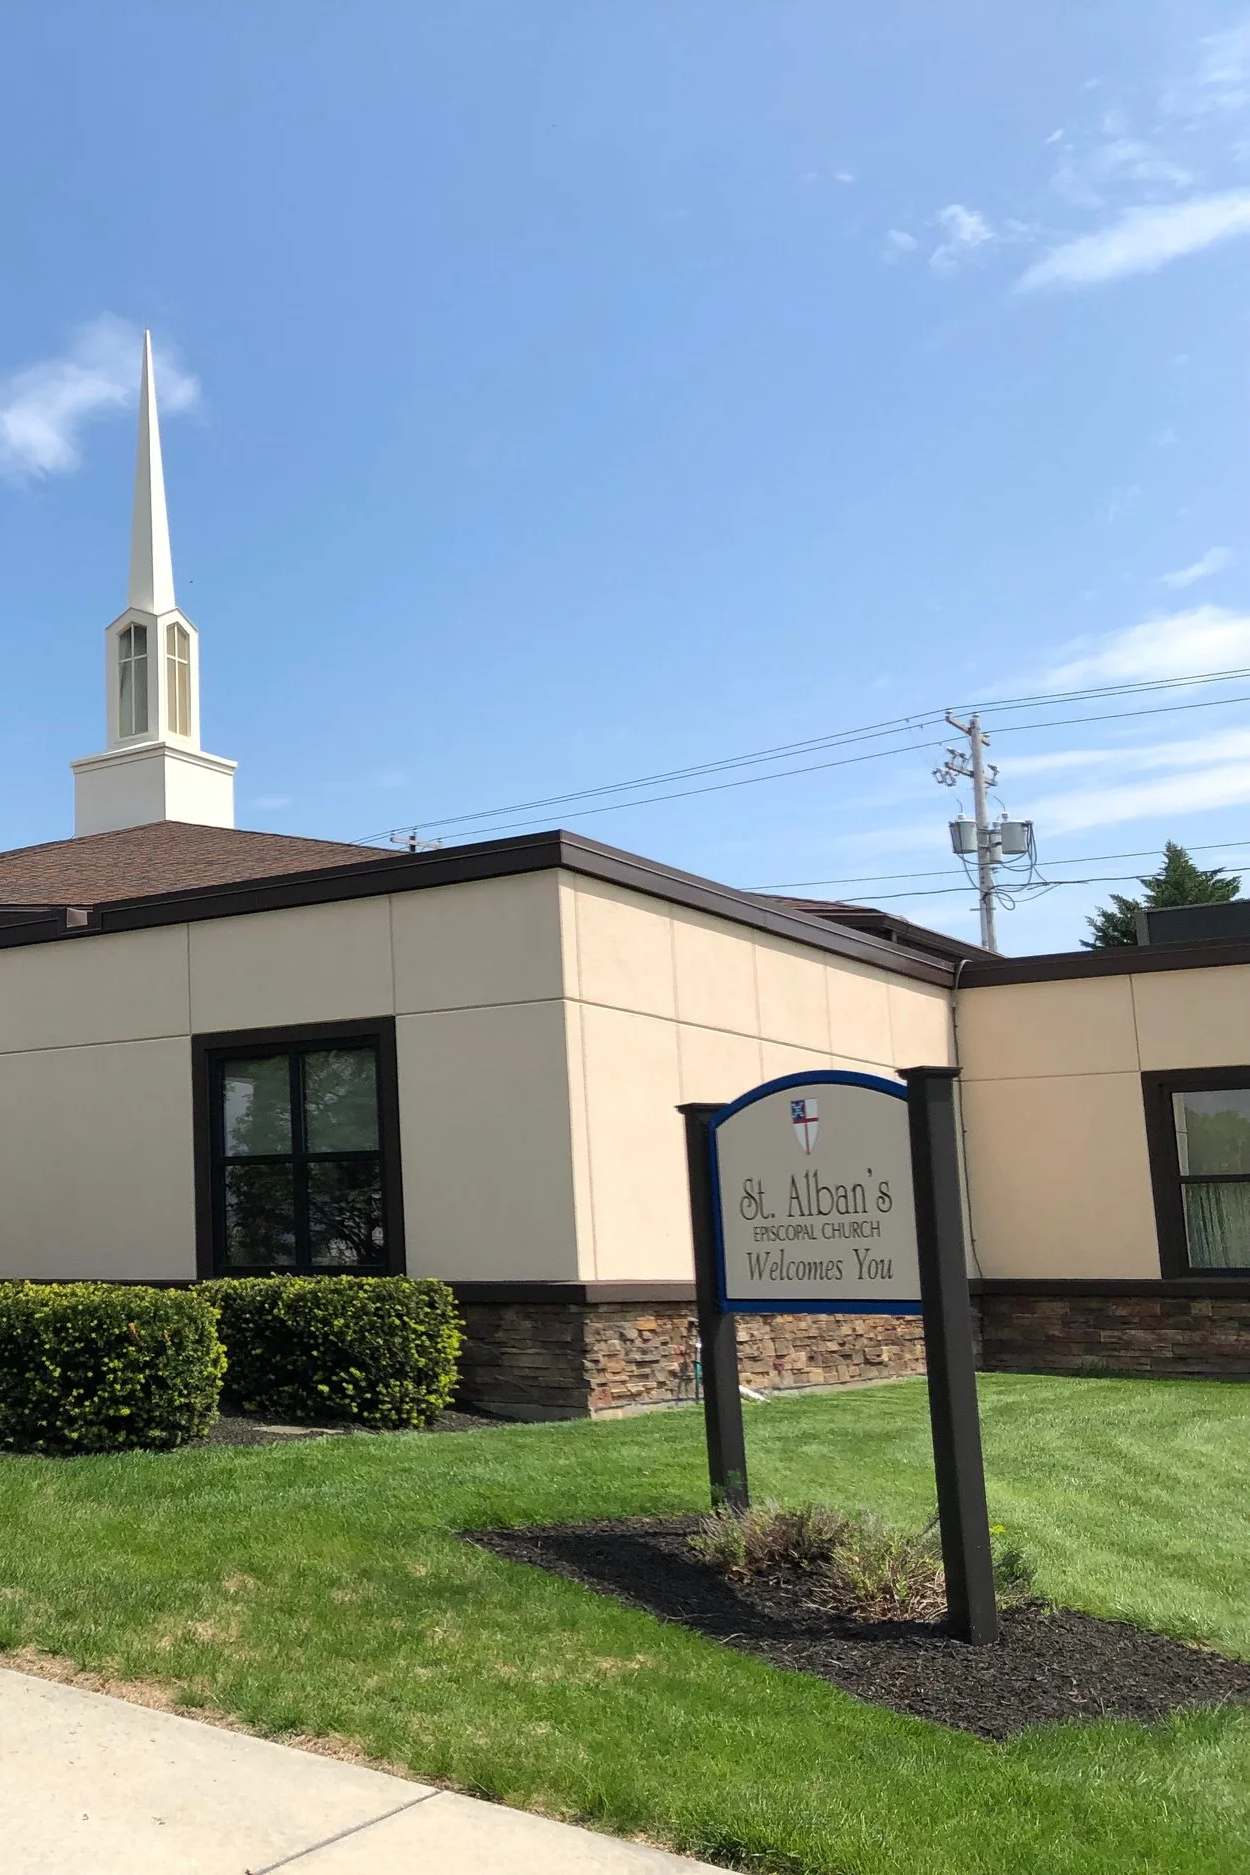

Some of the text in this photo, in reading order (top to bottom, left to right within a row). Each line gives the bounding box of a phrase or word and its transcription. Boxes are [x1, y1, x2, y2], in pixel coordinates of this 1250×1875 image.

[739, 1168, 893, 1221] St. Alban's
[753, 1220, 881, 1242] EPISCOPAL CHURCH
[746, 1248, 894, 1281] Welcomes You
